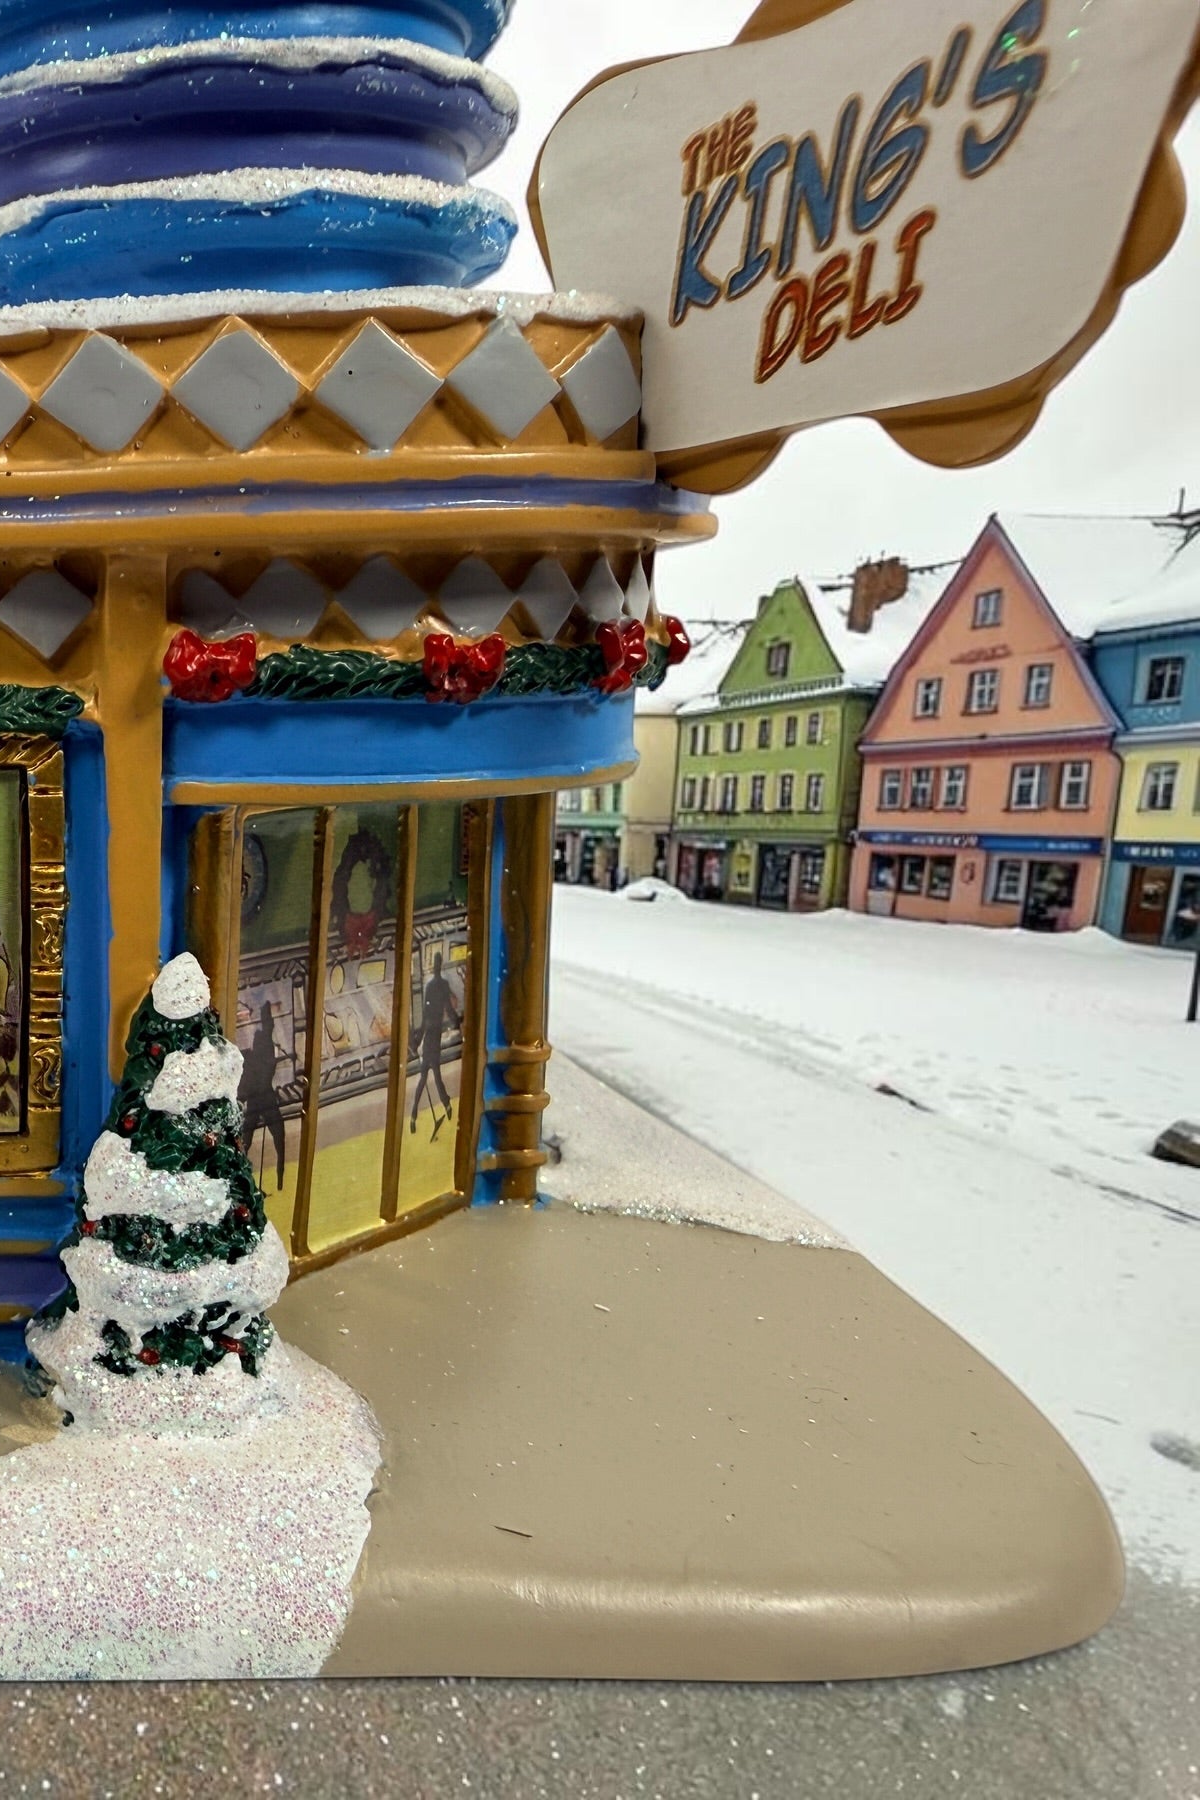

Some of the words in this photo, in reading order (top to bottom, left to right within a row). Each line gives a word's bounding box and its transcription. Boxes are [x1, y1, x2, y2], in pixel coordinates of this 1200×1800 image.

[669, 0, 1048, 328] KING'S
[681, 100, 757, 196] THE
[754, 204, 936, 384] DELI
